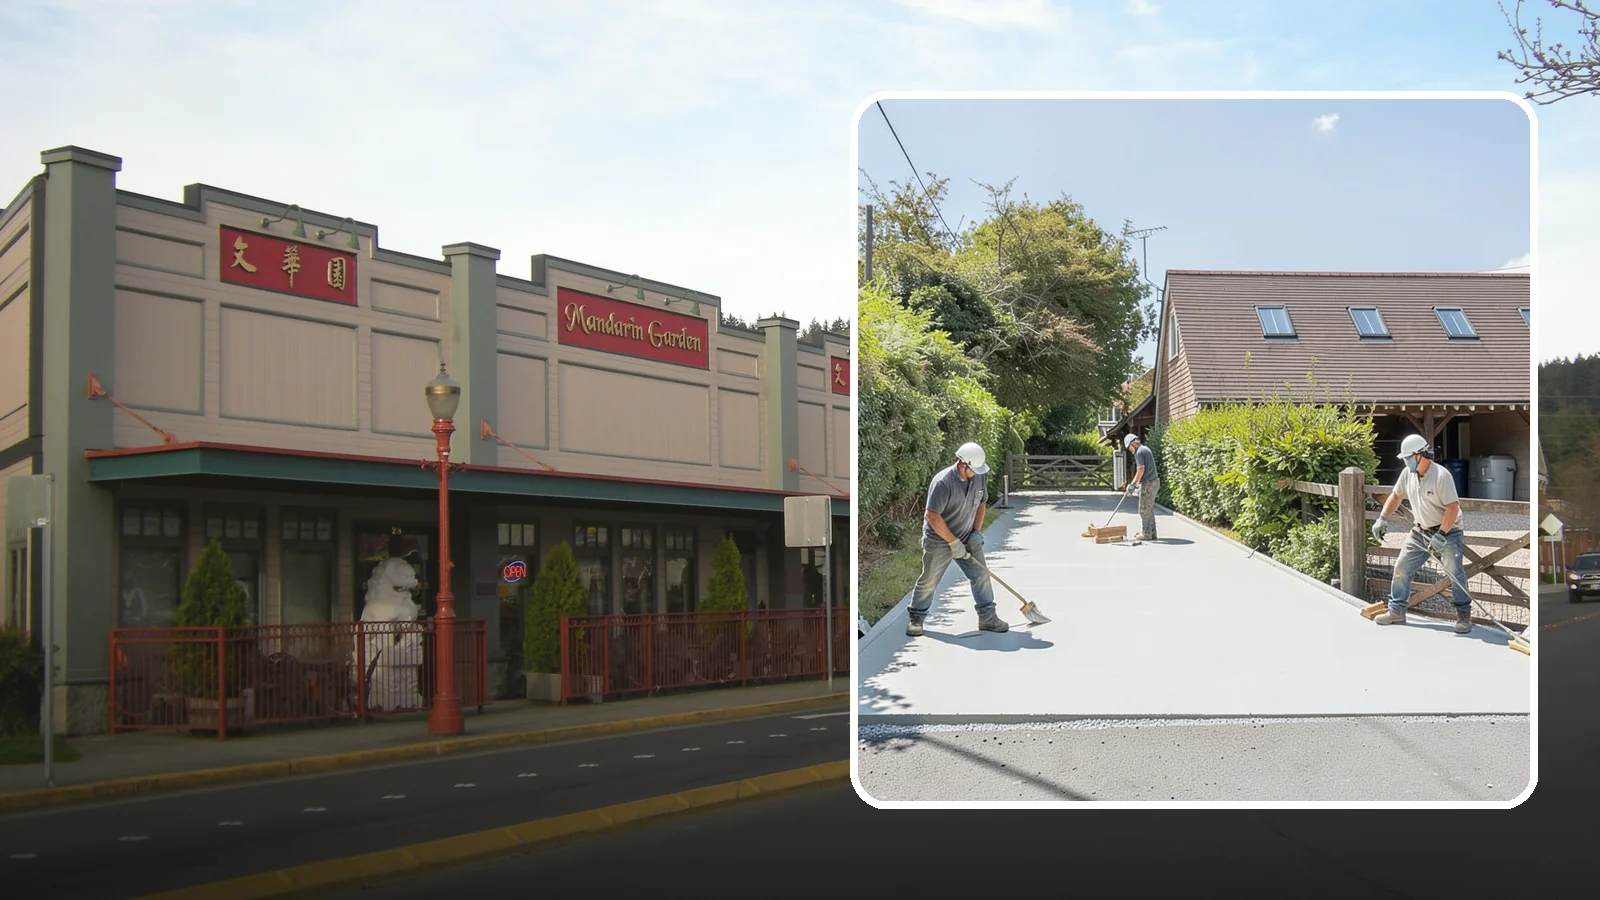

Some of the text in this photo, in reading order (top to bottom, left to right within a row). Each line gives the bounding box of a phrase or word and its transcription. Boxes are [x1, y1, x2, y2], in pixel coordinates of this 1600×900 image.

[231, 236, 346, 291] 文華園
[564, 302, 701, 352] Mandarin Garden
[503, 565, 527, 578] OPEN
